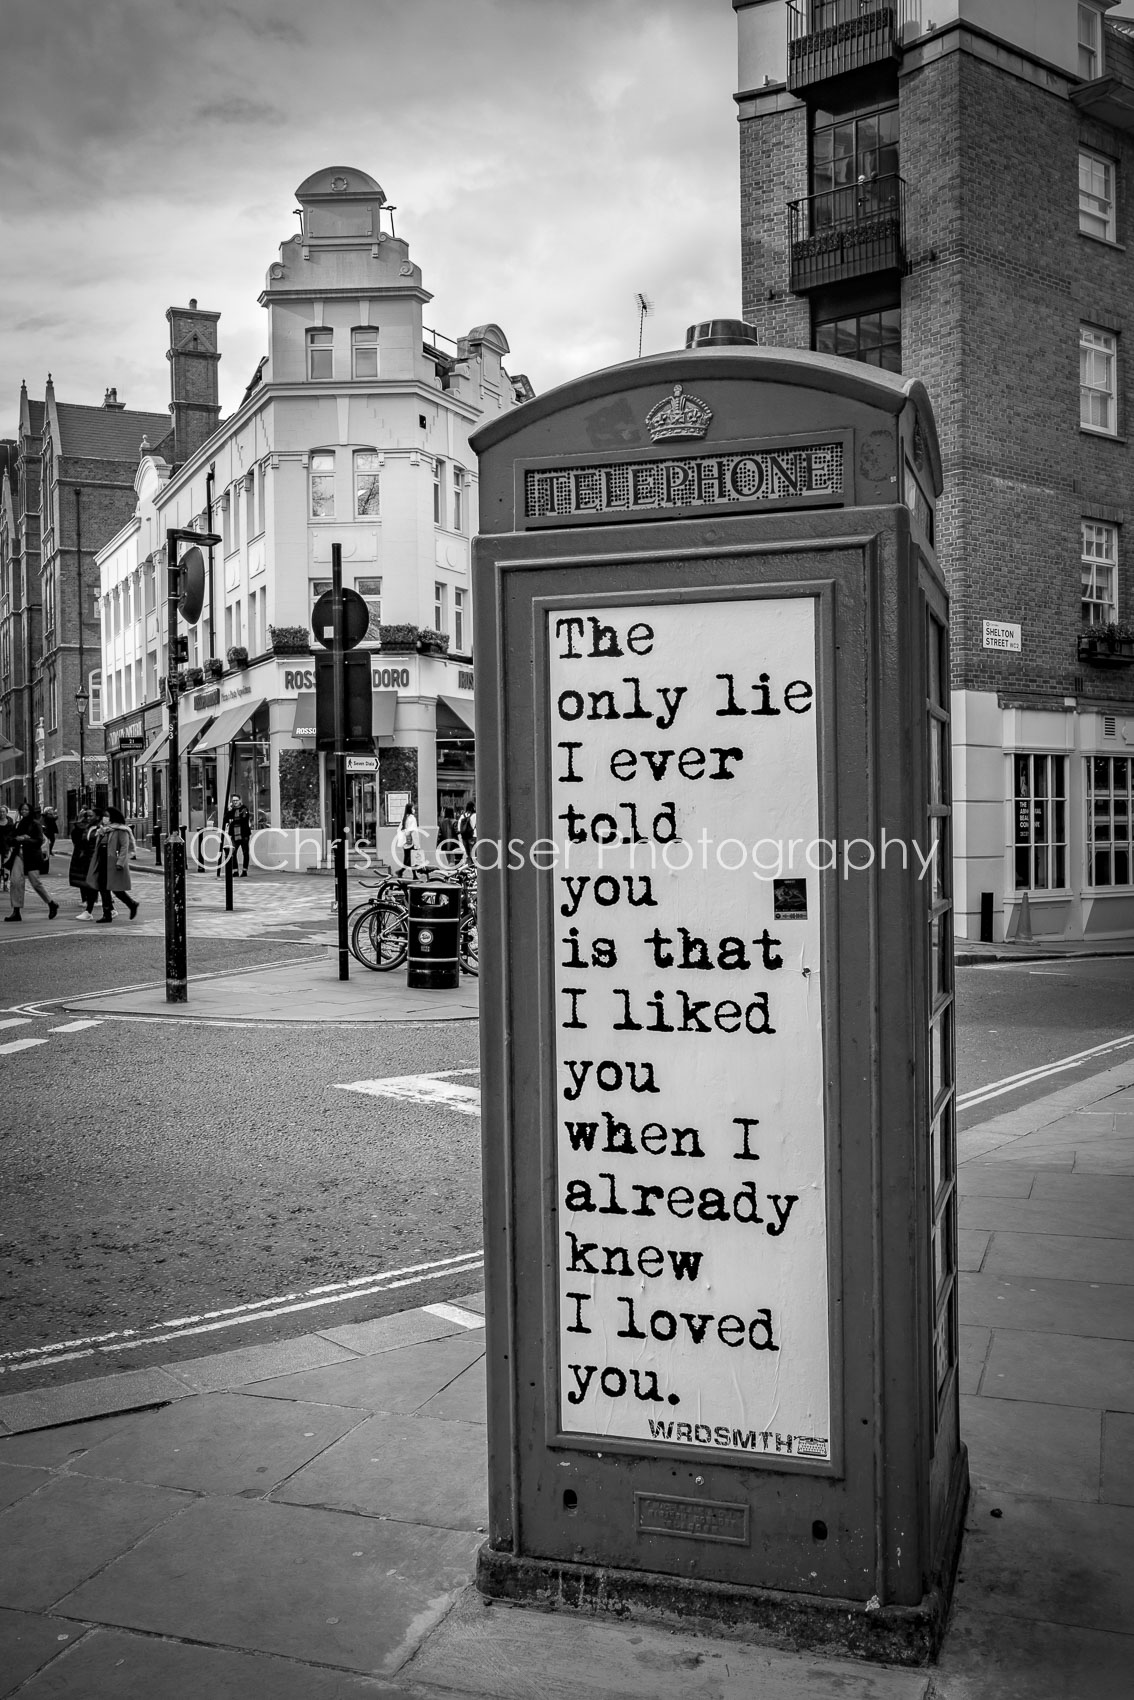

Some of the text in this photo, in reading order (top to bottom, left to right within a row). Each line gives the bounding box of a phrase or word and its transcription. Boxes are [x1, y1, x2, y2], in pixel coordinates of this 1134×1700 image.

[538, 452, 830, 513] TELEPHONE
[556, 616, 654, 659] The
[986, 627, 1014, 638] SHELTON
[986, 638, 1009, 647] STREET
[558, 673, 813, 729] only lie
[558, 741, 744, 782] I ever
[558, 802, 683, 844] told
[561, 875, 658, 917] you
[562, 926, 784, 971] is that
[561, 988, 777, 1035] I liked
[563, 1060, 661, 1101] you
[564, 1112, 760, 1161] when I
[564, 1173, 800, 1237] already
[565, 1231, 704, 1282] knew
[565, 1292, 780, 1352] I loved
[567, 1364, 681, 1406] you.
[647, 1419, 793, 1453] WRDSMTH
